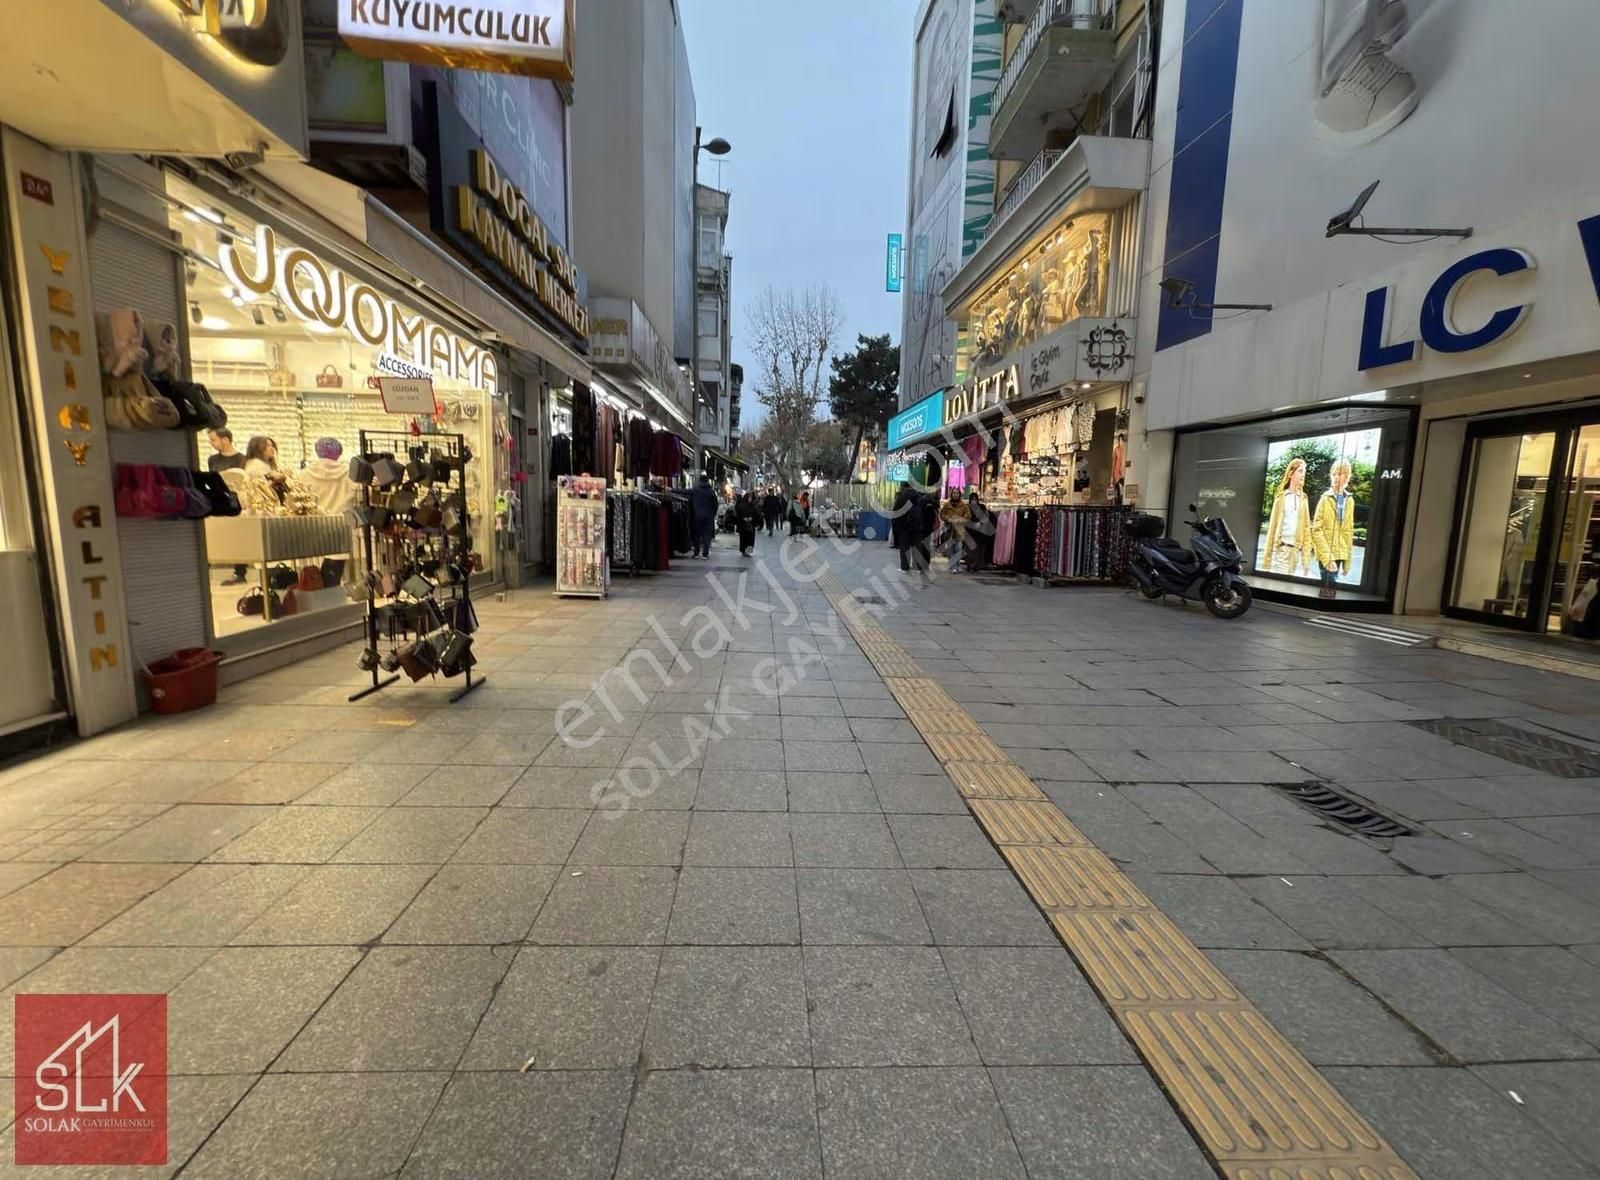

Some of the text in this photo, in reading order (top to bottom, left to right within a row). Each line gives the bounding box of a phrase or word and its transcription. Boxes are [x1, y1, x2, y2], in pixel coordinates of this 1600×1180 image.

[350, 0, 552, 46] KUYUMCULUK
[460, 186, 589, 338] KAYNAK MERKEZİ
[477, 149, 580, 293] DOĞAL SAÇ
[1358, 247, 1536, 371] LC
[1380, 469, 1403, 479] AM
[72, 504, 119, 673] ALTIN
